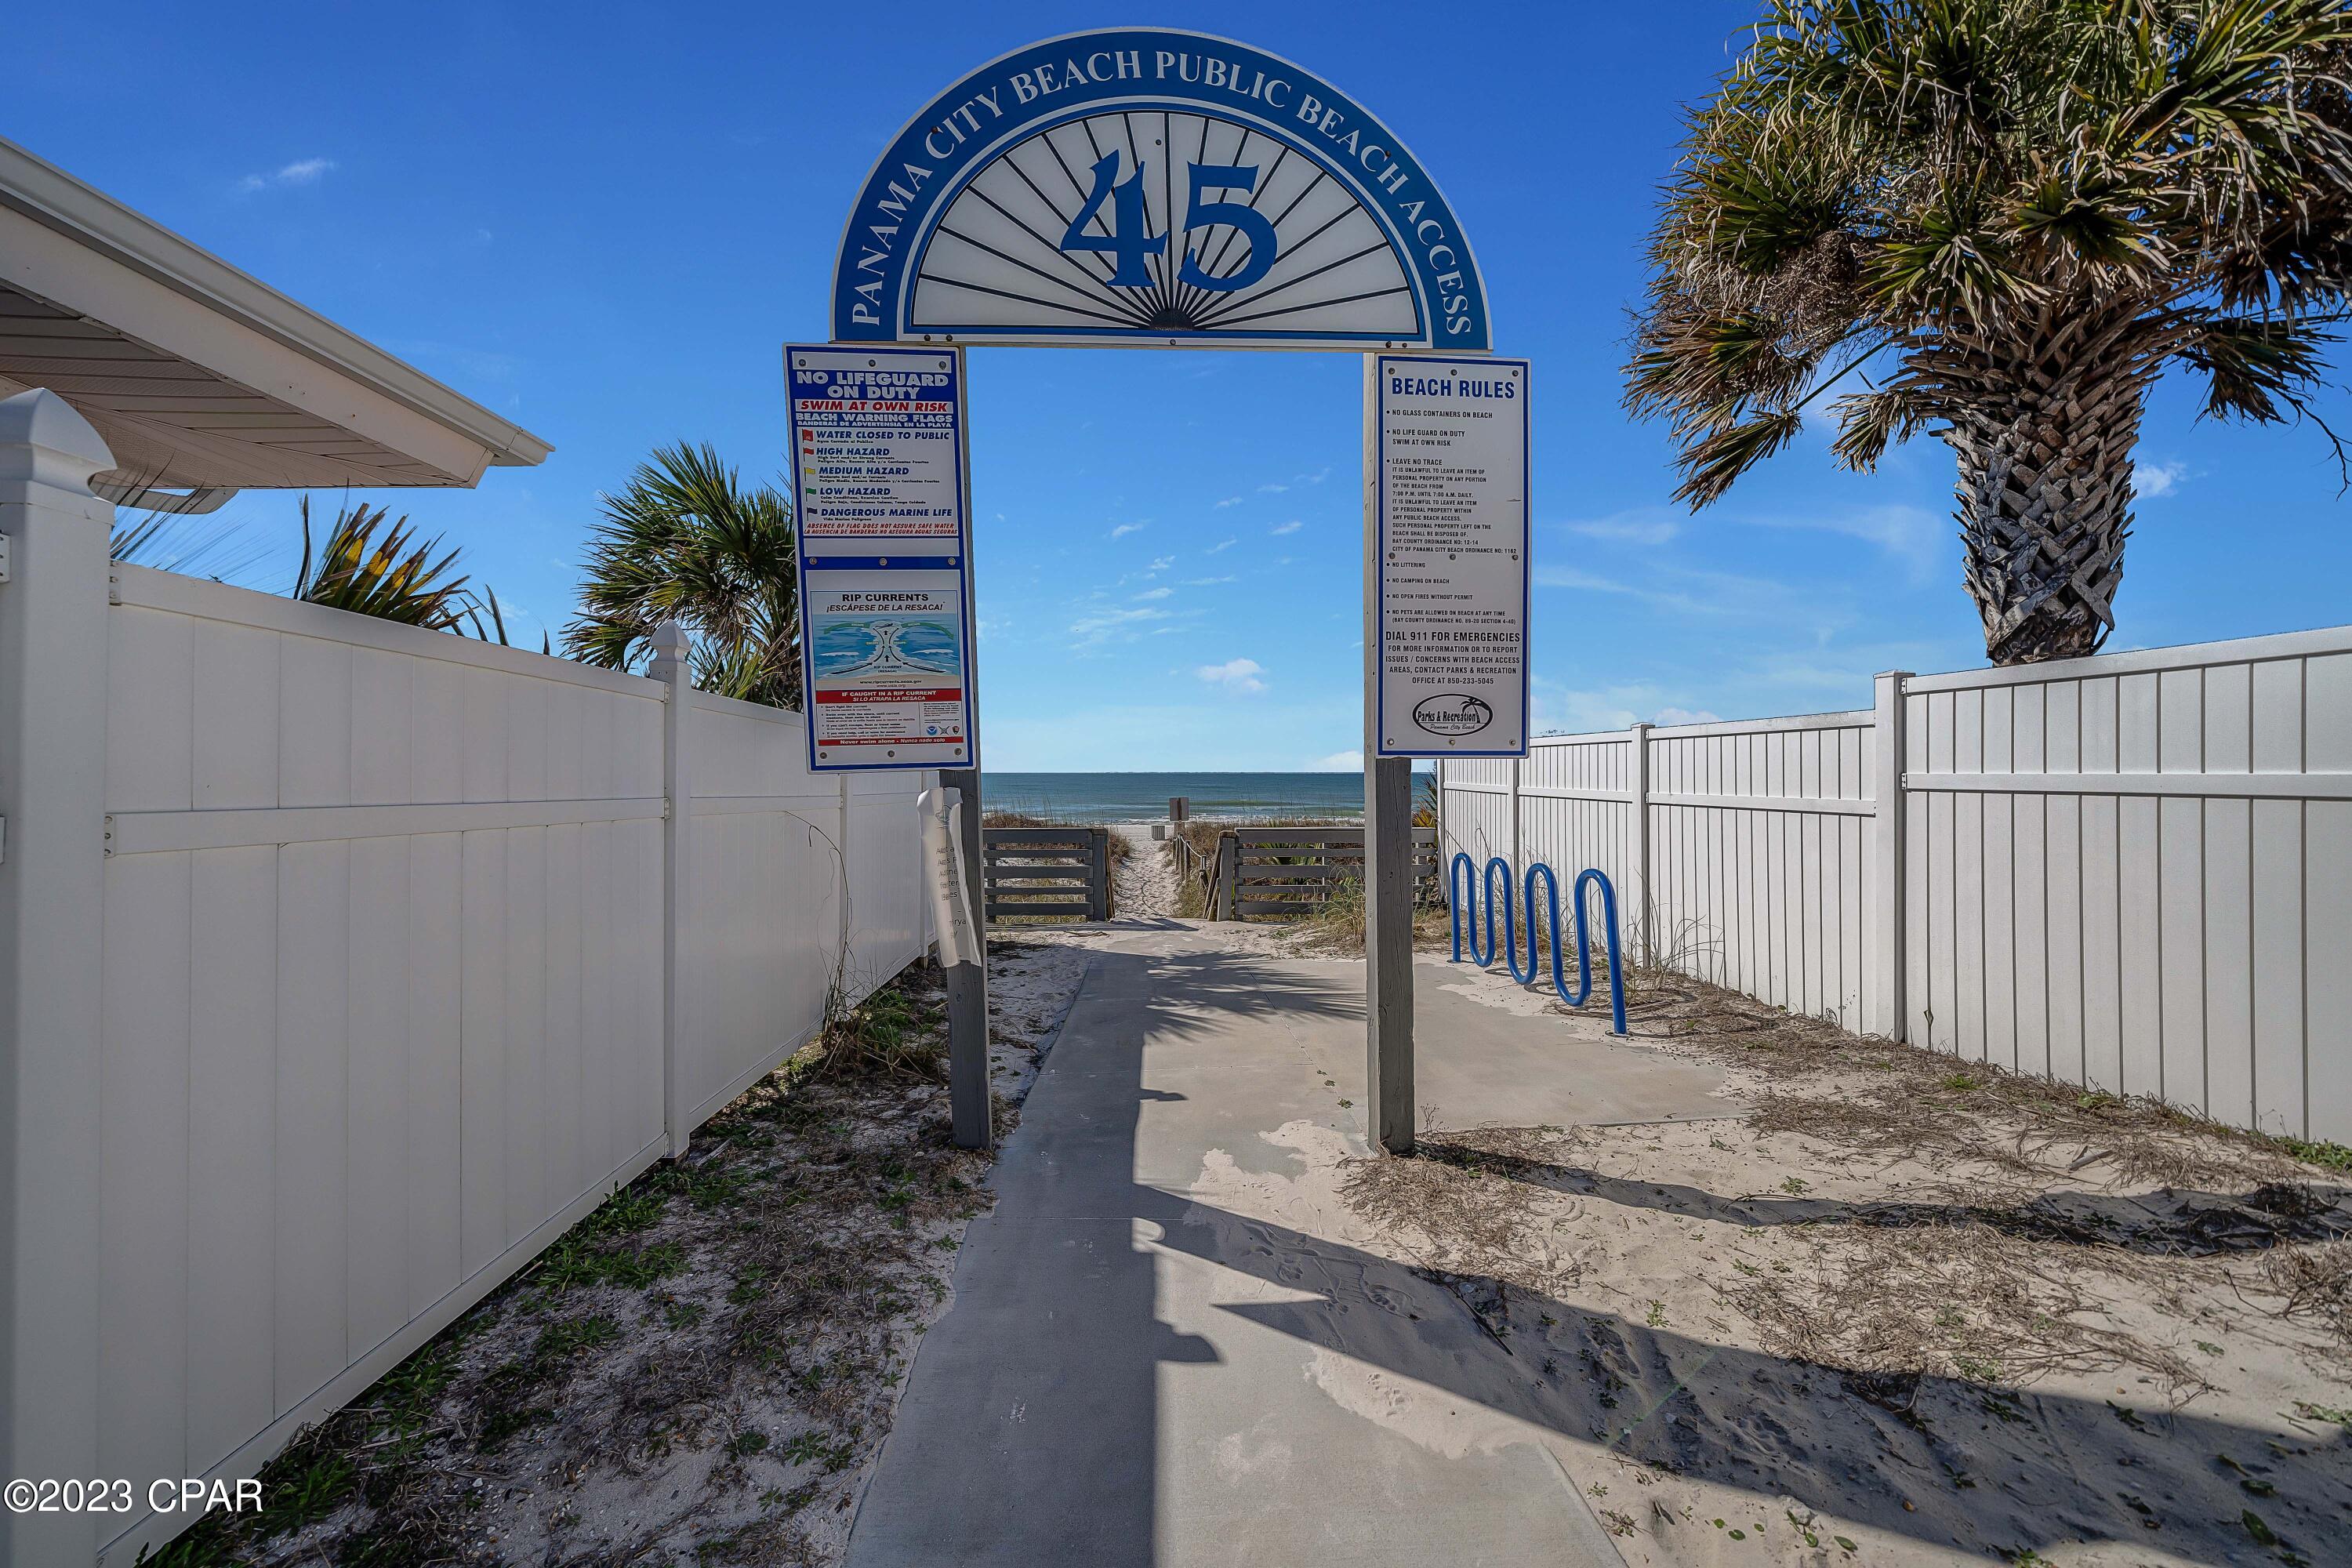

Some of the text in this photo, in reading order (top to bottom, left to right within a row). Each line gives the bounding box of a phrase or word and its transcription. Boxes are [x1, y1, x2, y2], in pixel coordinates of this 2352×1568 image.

[852, 49, 1472, 336] PANAMA CITY BEACH PUBLIC BEACH ACCESS
[1059, 148, 1278, 292] 45
[797, 372, 948, 387] NO LIFEGUARD
[828, 386, 920, 399] ON DUTY
[1392, 378, 1514, 398] BEACH RULES
[801, 401, 948, 412] SWIM AT OWN RISK
[827, 604, 876, 612] ¡ESCÁPESE
[1386, 632, 1520, 641] DIAL 911 FOR EMERGENCIES
[1417, 711, 1476, 721] Parks & Recreation
